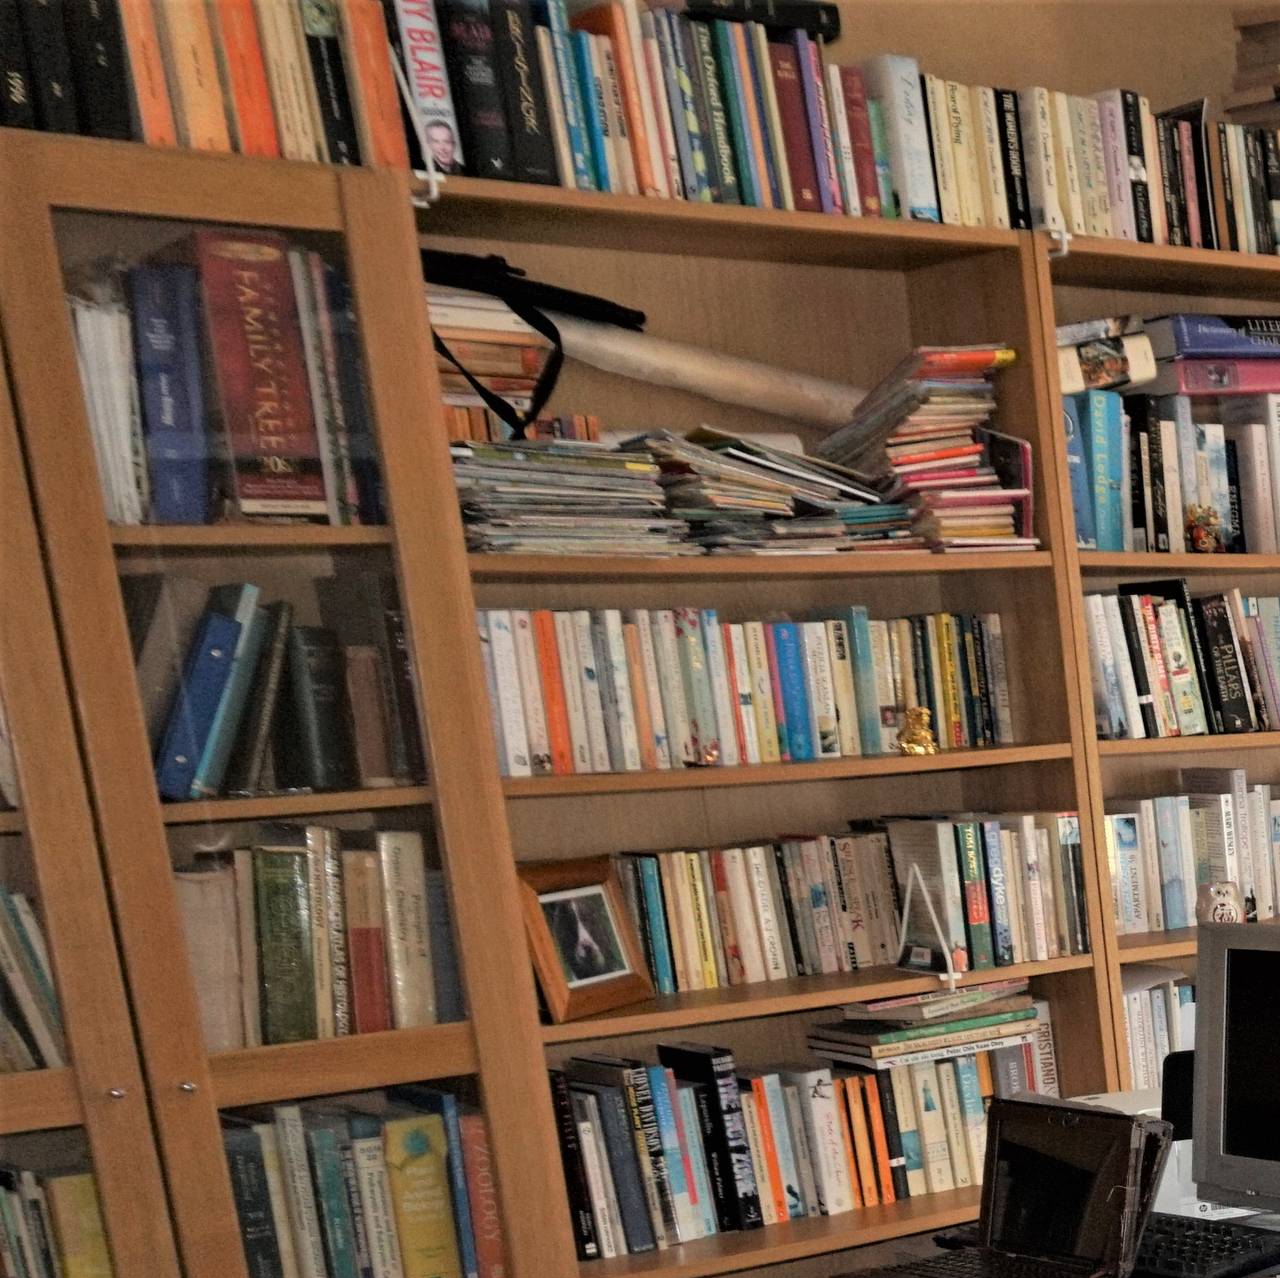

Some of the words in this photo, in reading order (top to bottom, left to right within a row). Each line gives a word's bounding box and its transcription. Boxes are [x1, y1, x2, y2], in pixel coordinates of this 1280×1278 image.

[699, 24, 710, 48] The
[405, 27, 446, 101] BLAIR
[703, 55, 722, 105] Oxford
[712, 109, 735, 185] Handbook
[235, 269, 276, 374] FAMILY
[254, 380, 285, 450] TREE
[1093, 395, 1106, 447] David
[1096, 452, 1109, 504] Lodge
[1230, 484, 1241, 536] ENIGMA
[1148, 623, 1160, 649] DIRTY
[1153, 652, 1165, 679] GAME
[1217, 676, 1229, 702] EARTH
[1221, 644, 1242, 702] PILLARS
[1224, 810, 1232, 828] MARY
[1225, 829, 1235, 856] WESLEY
[989, 867, 1008, 905] dyke
[1131, 866, 1142, 920] APARTMENT
[1037, 1022, 1054, 1085] CRISTIANO
[631, 1065, 652, 1099] LIONEL
[717, 1074, 735, 1110] THE
[638, 1102, 662, 1150] DAVIDSON
[723, 1110, 742, 1146] HOT
[477, 1143, 501, 1241] ZOOLOGY
[731, 1150, 754, 1198] ZONE
